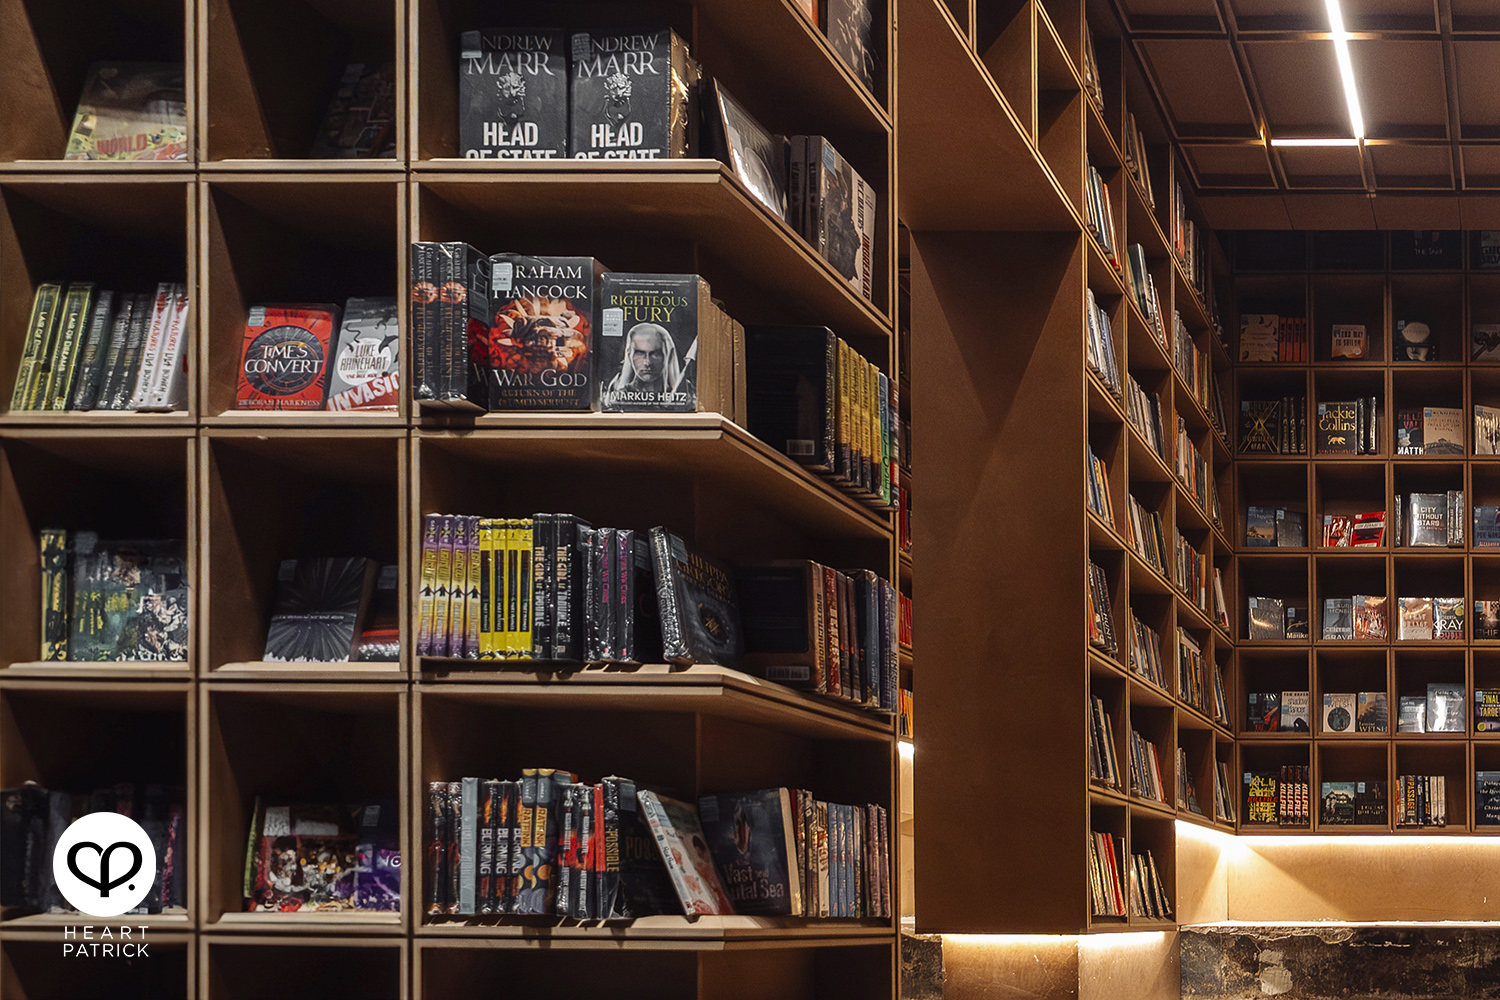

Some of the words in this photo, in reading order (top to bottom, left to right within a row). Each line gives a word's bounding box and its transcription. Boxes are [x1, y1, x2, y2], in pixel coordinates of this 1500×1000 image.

[482, 35, 553, 50] NDREW
[591, 35, 660, 52] NDREW
[467, 52, 556, 76] MARR
[577, 52, 660, 78] MARR
[483, 122, 538, 147] HEAD
[591, 122, 643, 148] HEAD
[515, 265, 583, 279] RAHAM
[610, 295, 688, 307] RIGHTEOUS
[624, 307, 675, 322] FURY
[355, 344, 376, 357] LUKE
[244, 359, 324, 374] CONVERT
[339, 356, 390, 372] RHINEHART
[492, 369, 535, 387] WAR
[540, 368, 587, 387] GOD
[611, 392, 655, 402] MARKUS
[657, 392, 687, 402] HEITZ
[1319, 419, 1355, 431] Collins
[535, 546, 545, 562] THE
[557, 546, 567, 562] THE
[1433, 619, 1464, 630] KRAY
[1482, 695, 1499, 704] FINAL
[521, 808, 532, 847] RATFINK
[534, 807, 548, 847] RATFINK
[480, 828, 492, 875] BURNING
[496, 828, 509, 875] BURNING
[725, 862, 753, 883] Vast
[761, 881, 784, 898] Sea
